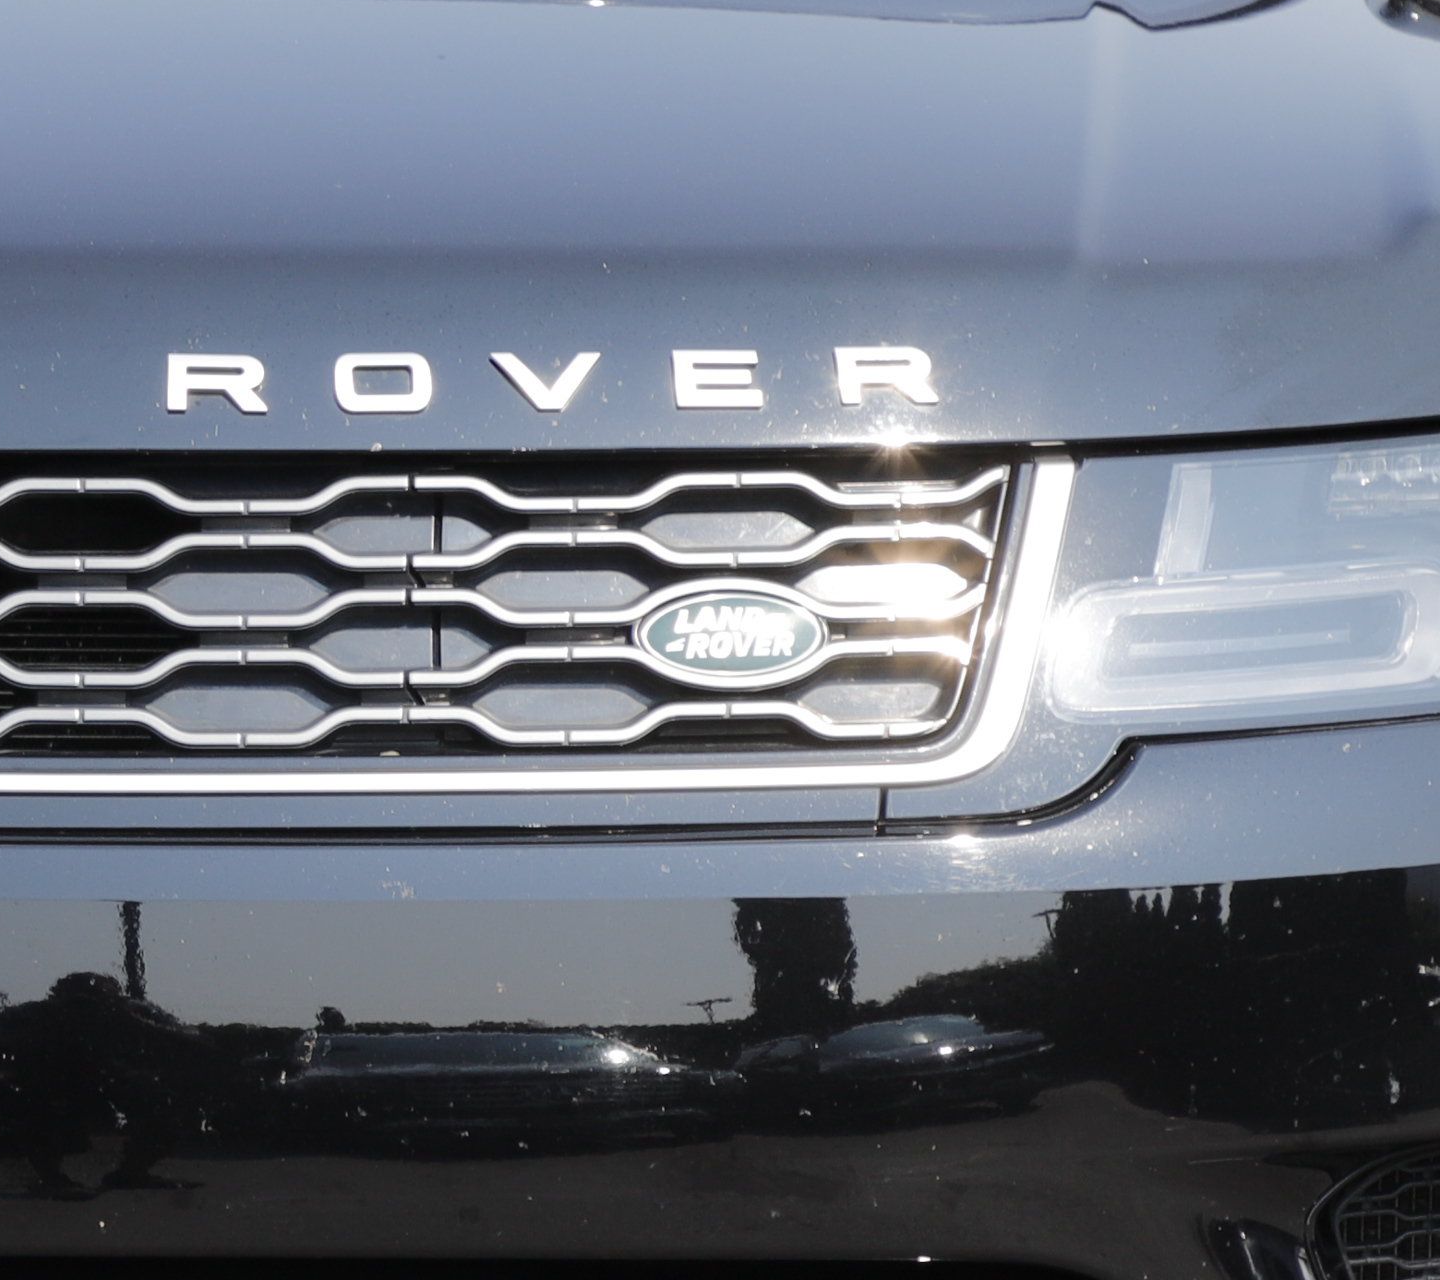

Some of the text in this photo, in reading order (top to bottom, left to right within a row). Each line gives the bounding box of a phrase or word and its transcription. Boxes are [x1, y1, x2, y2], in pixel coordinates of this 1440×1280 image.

[166, 345, 940, 414] ROVER
[674, 606, 768, 634] LAND
[685, 631, 795, 659] ROVER
